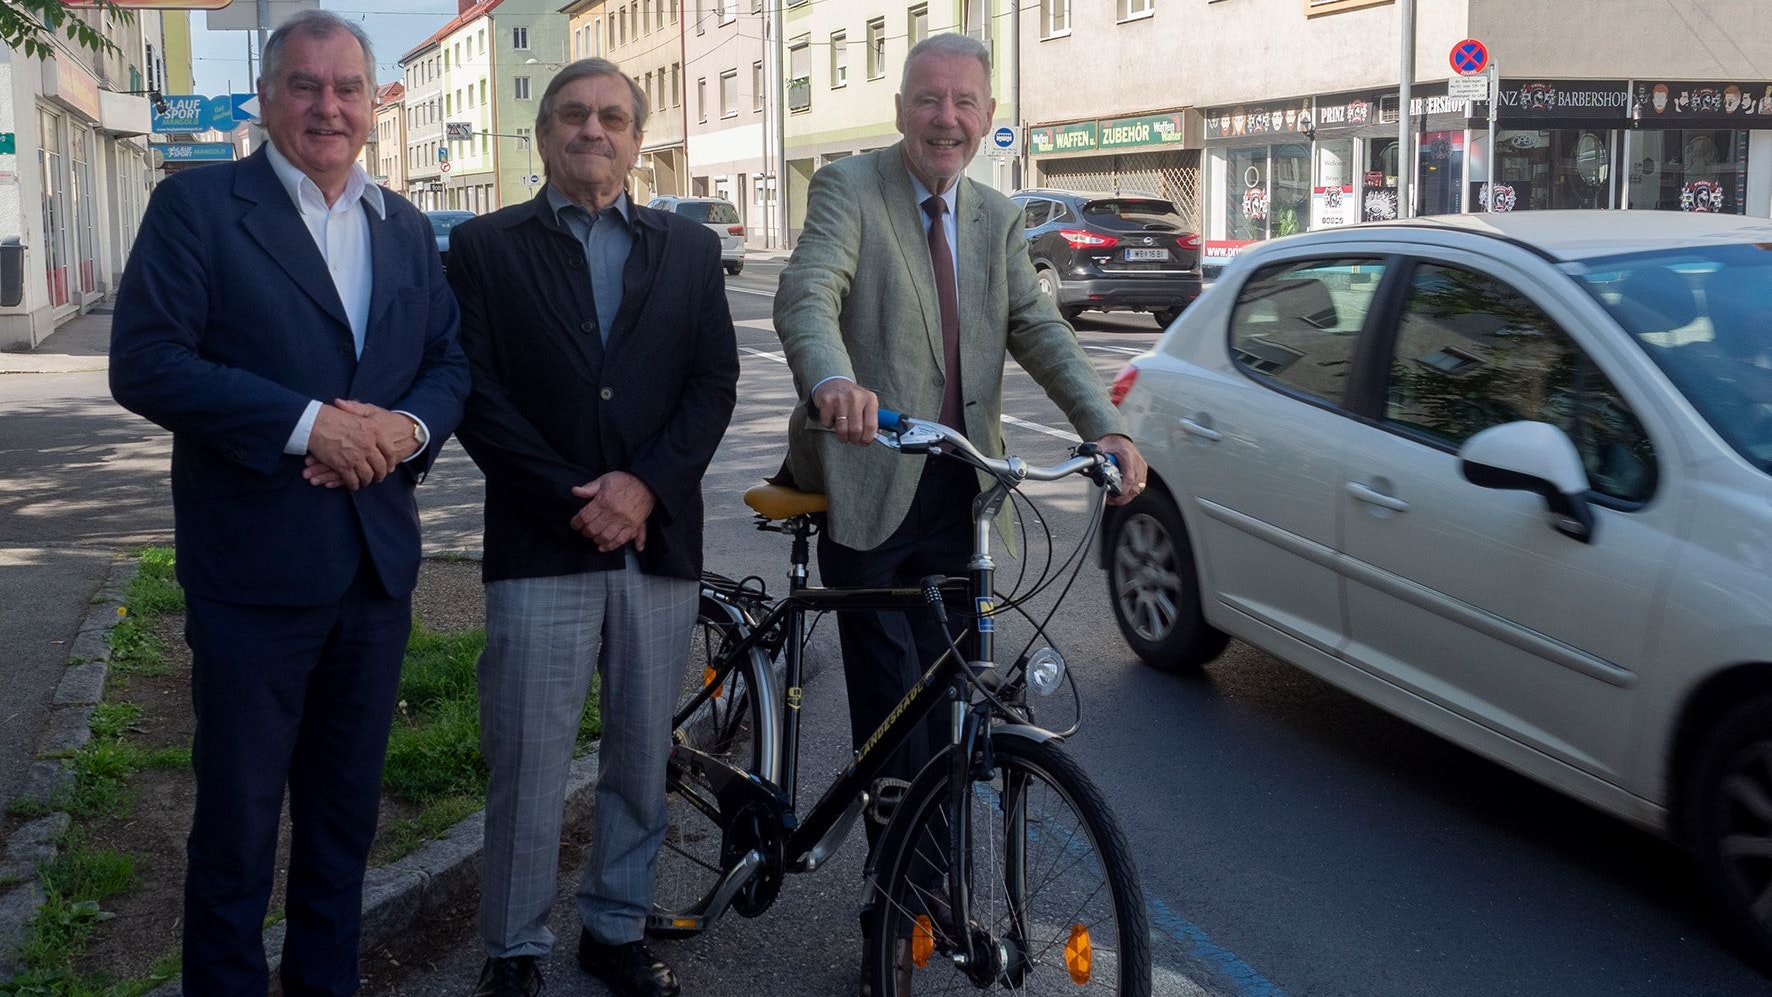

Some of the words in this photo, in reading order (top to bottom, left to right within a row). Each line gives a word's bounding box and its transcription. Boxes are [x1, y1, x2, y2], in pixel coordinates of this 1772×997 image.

[170, 100, 200, 109] LAUF
[1558, 91, 1627, 107] BARBERSHOP
[164, 109, 201, 119] SPORT
[1320, 106, 1345, 123] PRINZ
[1409, 96, 1465, 115] ARBERSHOP
[1056, 131, 1089, 149] WAFFEN
[1102, 122, 1150, 144] ZUBEHÖR
